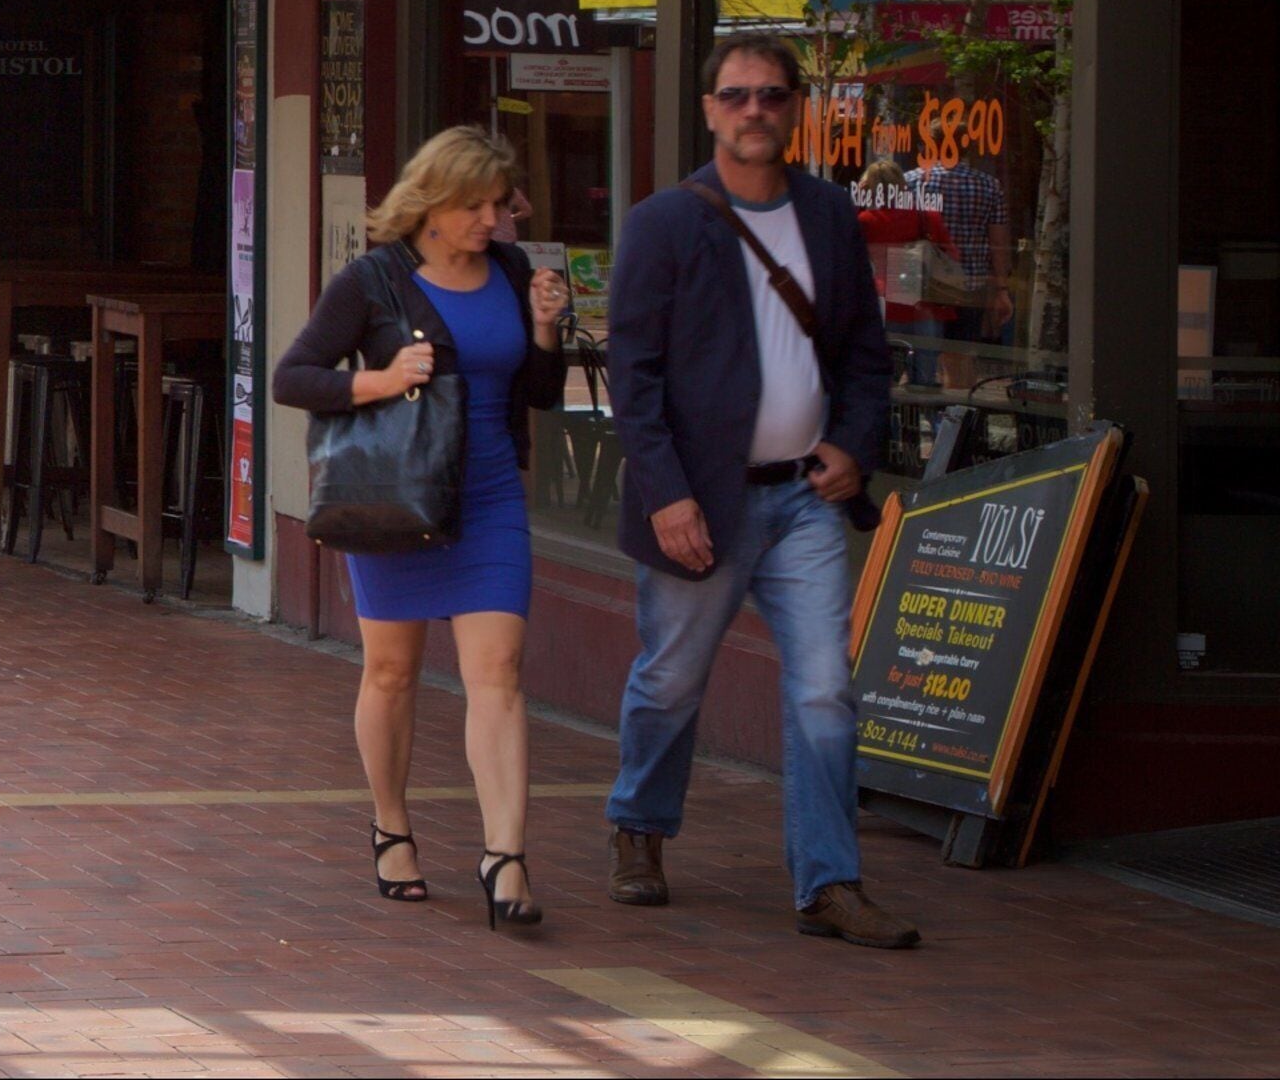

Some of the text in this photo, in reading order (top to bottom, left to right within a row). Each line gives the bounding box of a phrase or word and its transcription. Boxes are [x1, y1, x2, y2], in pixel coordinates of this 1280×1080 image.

[0, 57, 82, 75] ISTOL
[324, 83, 362, 106] NOW
[784, 90, 1004, 181] UNCH from $8.90
[850, 181, 943, 212] Rice & Plain Naan
[917, 543, 962, 558] Indian Cuisine
[922, 528, 968, 547] Contemporary
[911, 559, 933, 576] FULLY
[934, 563, 975, 581] LICENSED
[980, 571, 998, 585] BYO
[999, 573, 1023, 590] WINE
[899, 591, 1006, 628] SUPER DINNER
[895, 616, 995, 650] Specials Takeout
[960, 655, 979, 670] Curry
[888, 665, 971, 701] for just $12.00
[862, 691, 877, 703] with
[877, 695, 925, 716] complimentary
[925, 703, 940, 716] rice
[947, 707, 966, 721] plain
[967, 713, 986, 724] naan
[863, 720, 886, 741] 802
[887, 730, 918, 751] 4144
